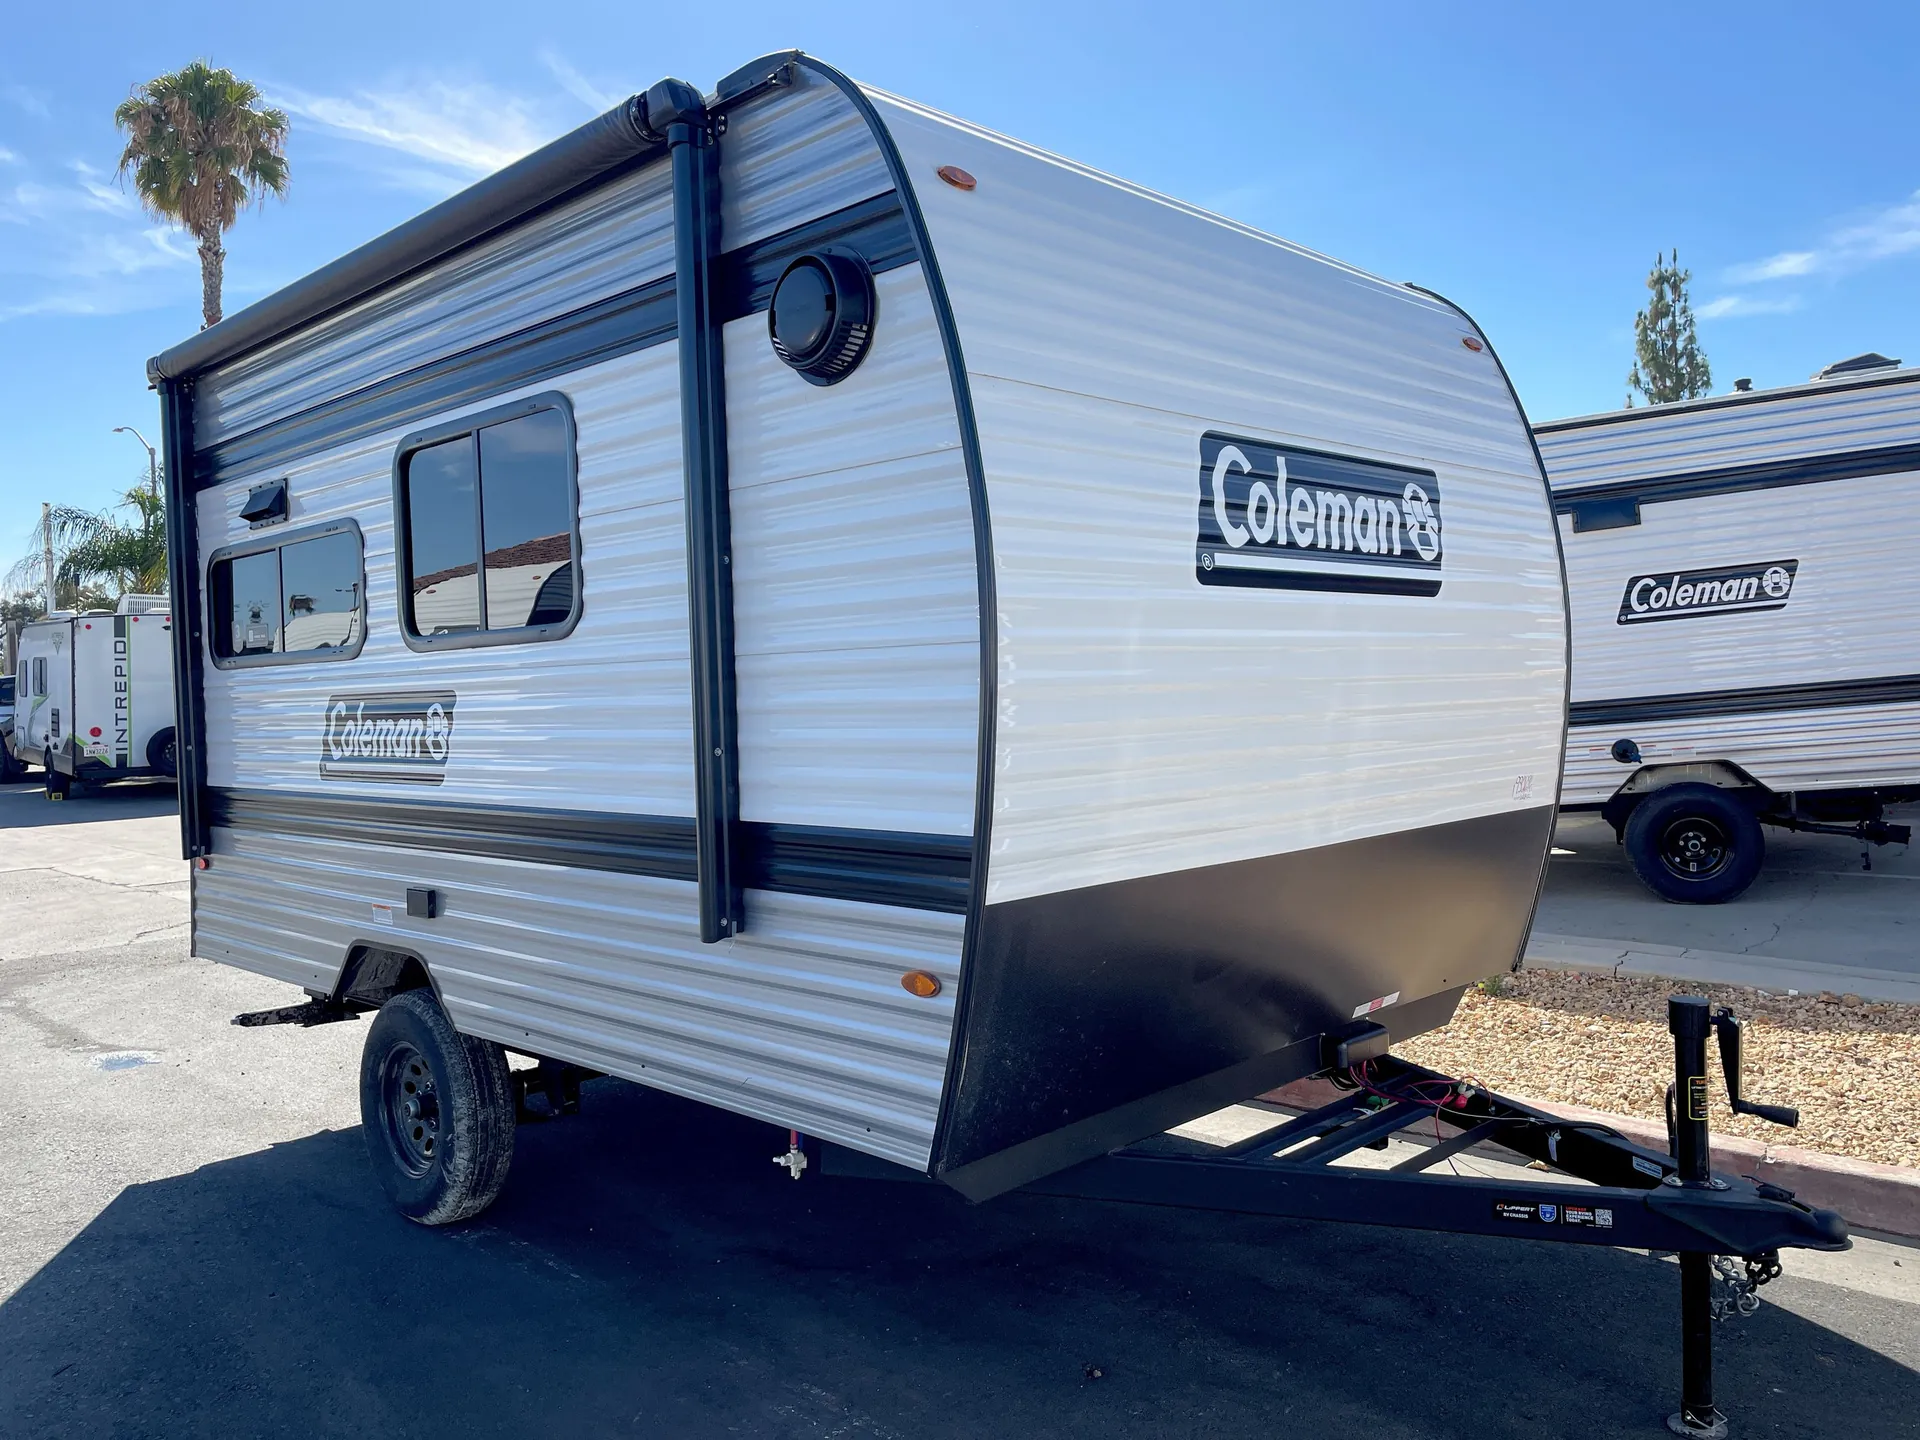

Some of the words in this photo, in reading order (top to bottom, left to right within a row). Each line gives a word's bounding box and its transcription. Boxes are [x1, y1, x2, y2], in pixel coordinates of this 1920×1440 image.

[1212, 444, 1402, 556] Coleman
[1630, 575, 1759, 613] Coleman
[114, 640, 128, 751] INTREPID
[328, 700, 424, 760] Coleman
